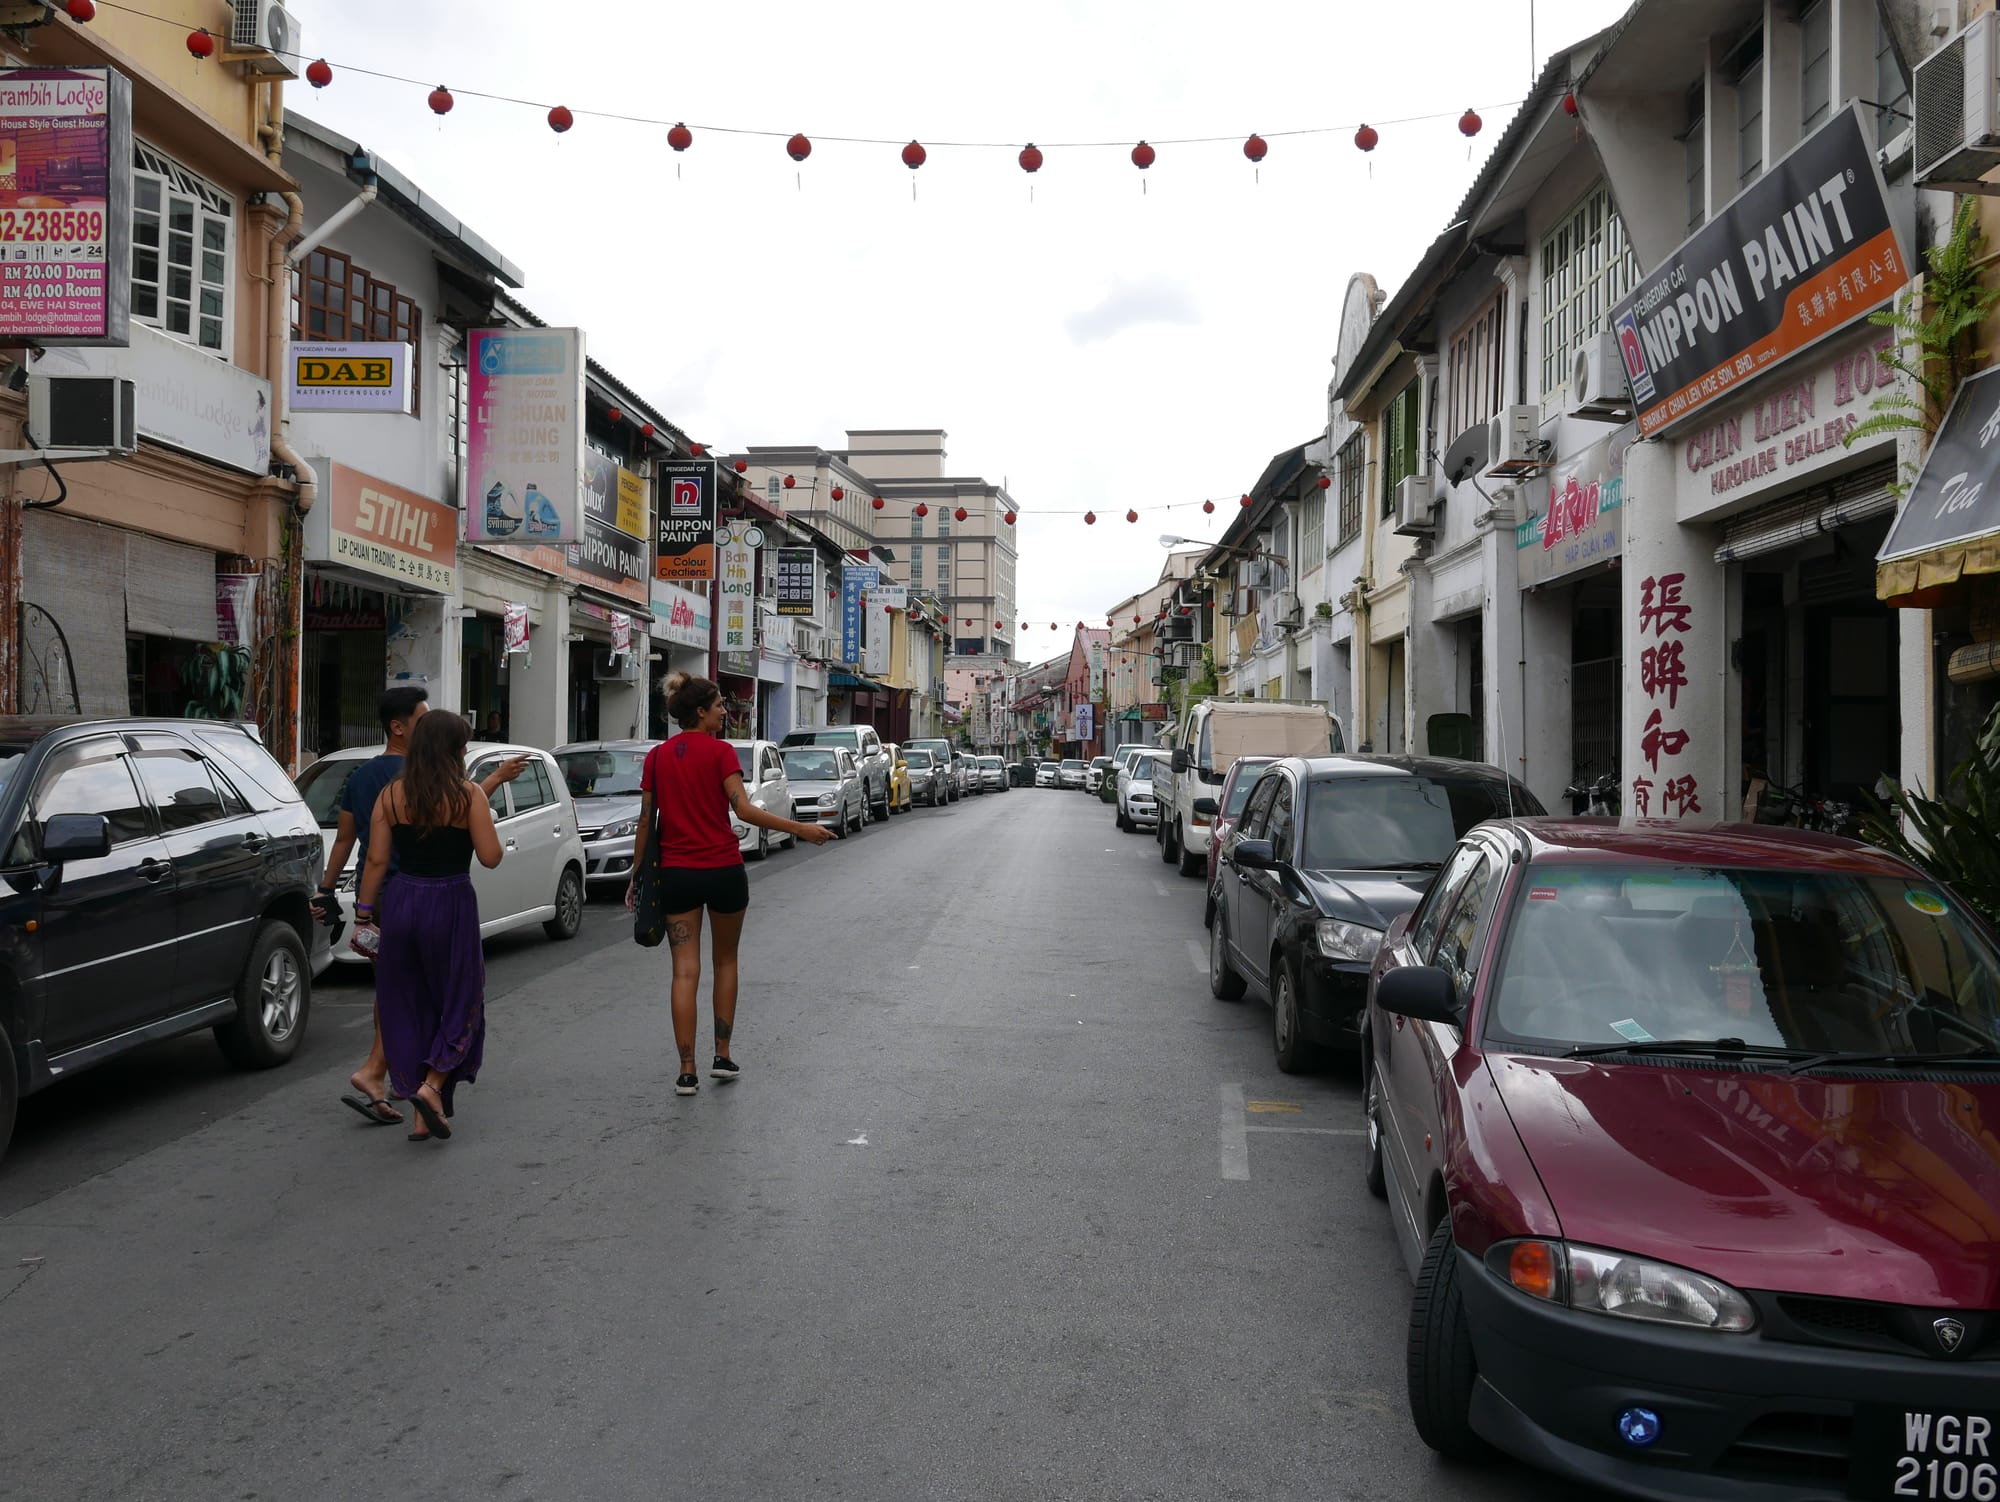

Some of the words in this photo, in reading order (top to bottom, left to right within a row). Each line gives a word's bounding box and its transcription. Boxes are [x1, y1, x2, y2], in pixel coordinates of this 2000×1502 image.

[57, 81, 104, 114] Lodge
[1, 120, 27, 129] House
[29, 120, 50, 130] Style
[52, 119, 77, 129] Guest
[79, 119, 105, 129] House
[5, 267, 21, 279] RM
[24, 264, 62, 280] 20.00
[66, 265, 102, 280] Dorm
[1640, 260, 1744, 374] NIPPON
[1742, 172, 1854, 302] PAINT
[3, 286, 20, 298] RM
[24, 283, 63, 300] 40.00
[66, 282, 102, 297] Room
[1633, 281, 1672, 321] PENGEDAR
[1670, 264, 1688, 290] CAT
[20, 301, 44, 310] EWE
[47, 301, 66, 310] HAI
[69, 301, 102, 310] Street
[303, 362, 386, 381] DAB
[1668, 396, 1687, 415] CHAN
[1686, 385, 1702, 405] LIEN
[1700, 375, 1718, 394] HOE
[1735, 354, 1756, 375] BHD.
[194, 389, 241, 441] Lodge
[1686, 415, 1743, 473] CHAN
[1754, 376, 1816, 443] LIEN
[1834, 337, 1896, 407] HOE
[483, 427, 561, 447] TADING
[1711, 446, 1778, 496] HARDWARE
[1784, 413, 1858, 466] DEALERS
[583, 485, 603, 513] ulux
[1935, 472, 1984, 520] Tea
[355, 487, 434, 553] STIHL
[660, 520, 712, 531] NIPPON
[660, 531, 699, 543] PAINT
[1602, 529, 1616, 551] HIN
[338, 536, 348, 554] LIP
[349, 540, 371, 562] CHUAN
[371, 546, 396, 570] TRADING
[580, 535, 617, 572] NIPPON
[619, 549, 644, 581] PAINT
[673, 557, 707, 567] Colour
[725, 551, 749, 563] Ban
[660, 567, 707, 577] Creations
[726, 564, 747, 578] Hin
[721, 581, 752, 597] Long
[1904, 1412, 1992, 1457] WGR
[1893, 1456, 2000, 1502] 2106
